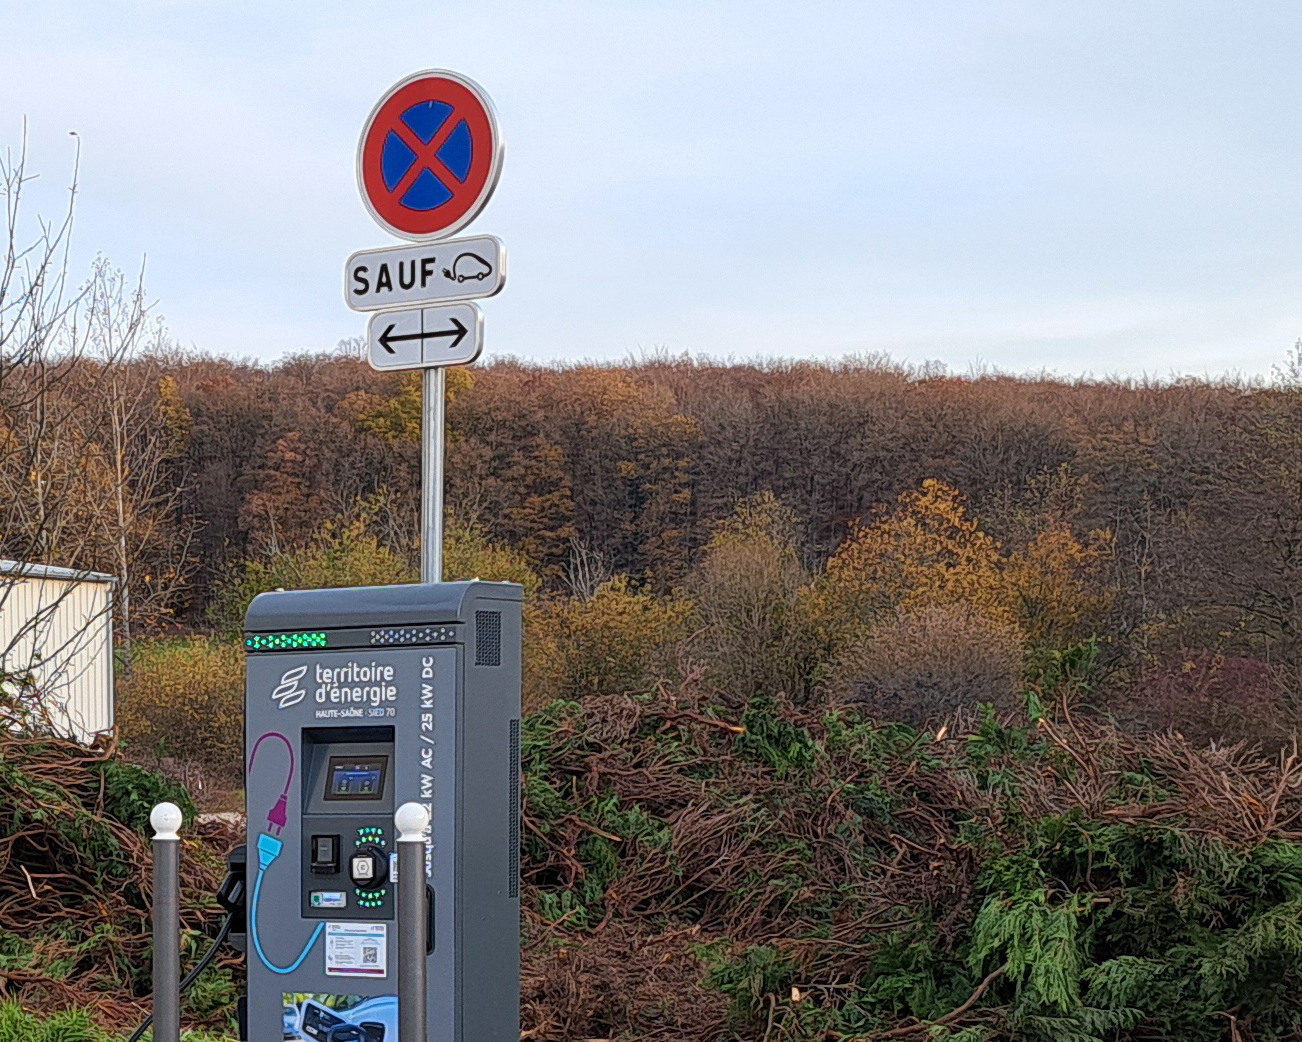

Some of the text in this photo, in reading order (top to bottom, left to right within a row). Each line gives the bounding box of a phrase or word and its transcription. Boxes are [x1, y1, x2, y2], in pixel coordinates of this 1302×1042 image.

[353, 257, 436, 296] SAUF
[316, 661, 394, 684] territoire
[421, 656, 434, 679] DC
[315, 682, 397, 706] d'énergie
[420, 683, 434, 708] kW
[386, 707, 396, 717] 70
[421, 713, 433, 732] 25
[420, 748, 433, 769] AC
[420, 773, 434, 798] kW
